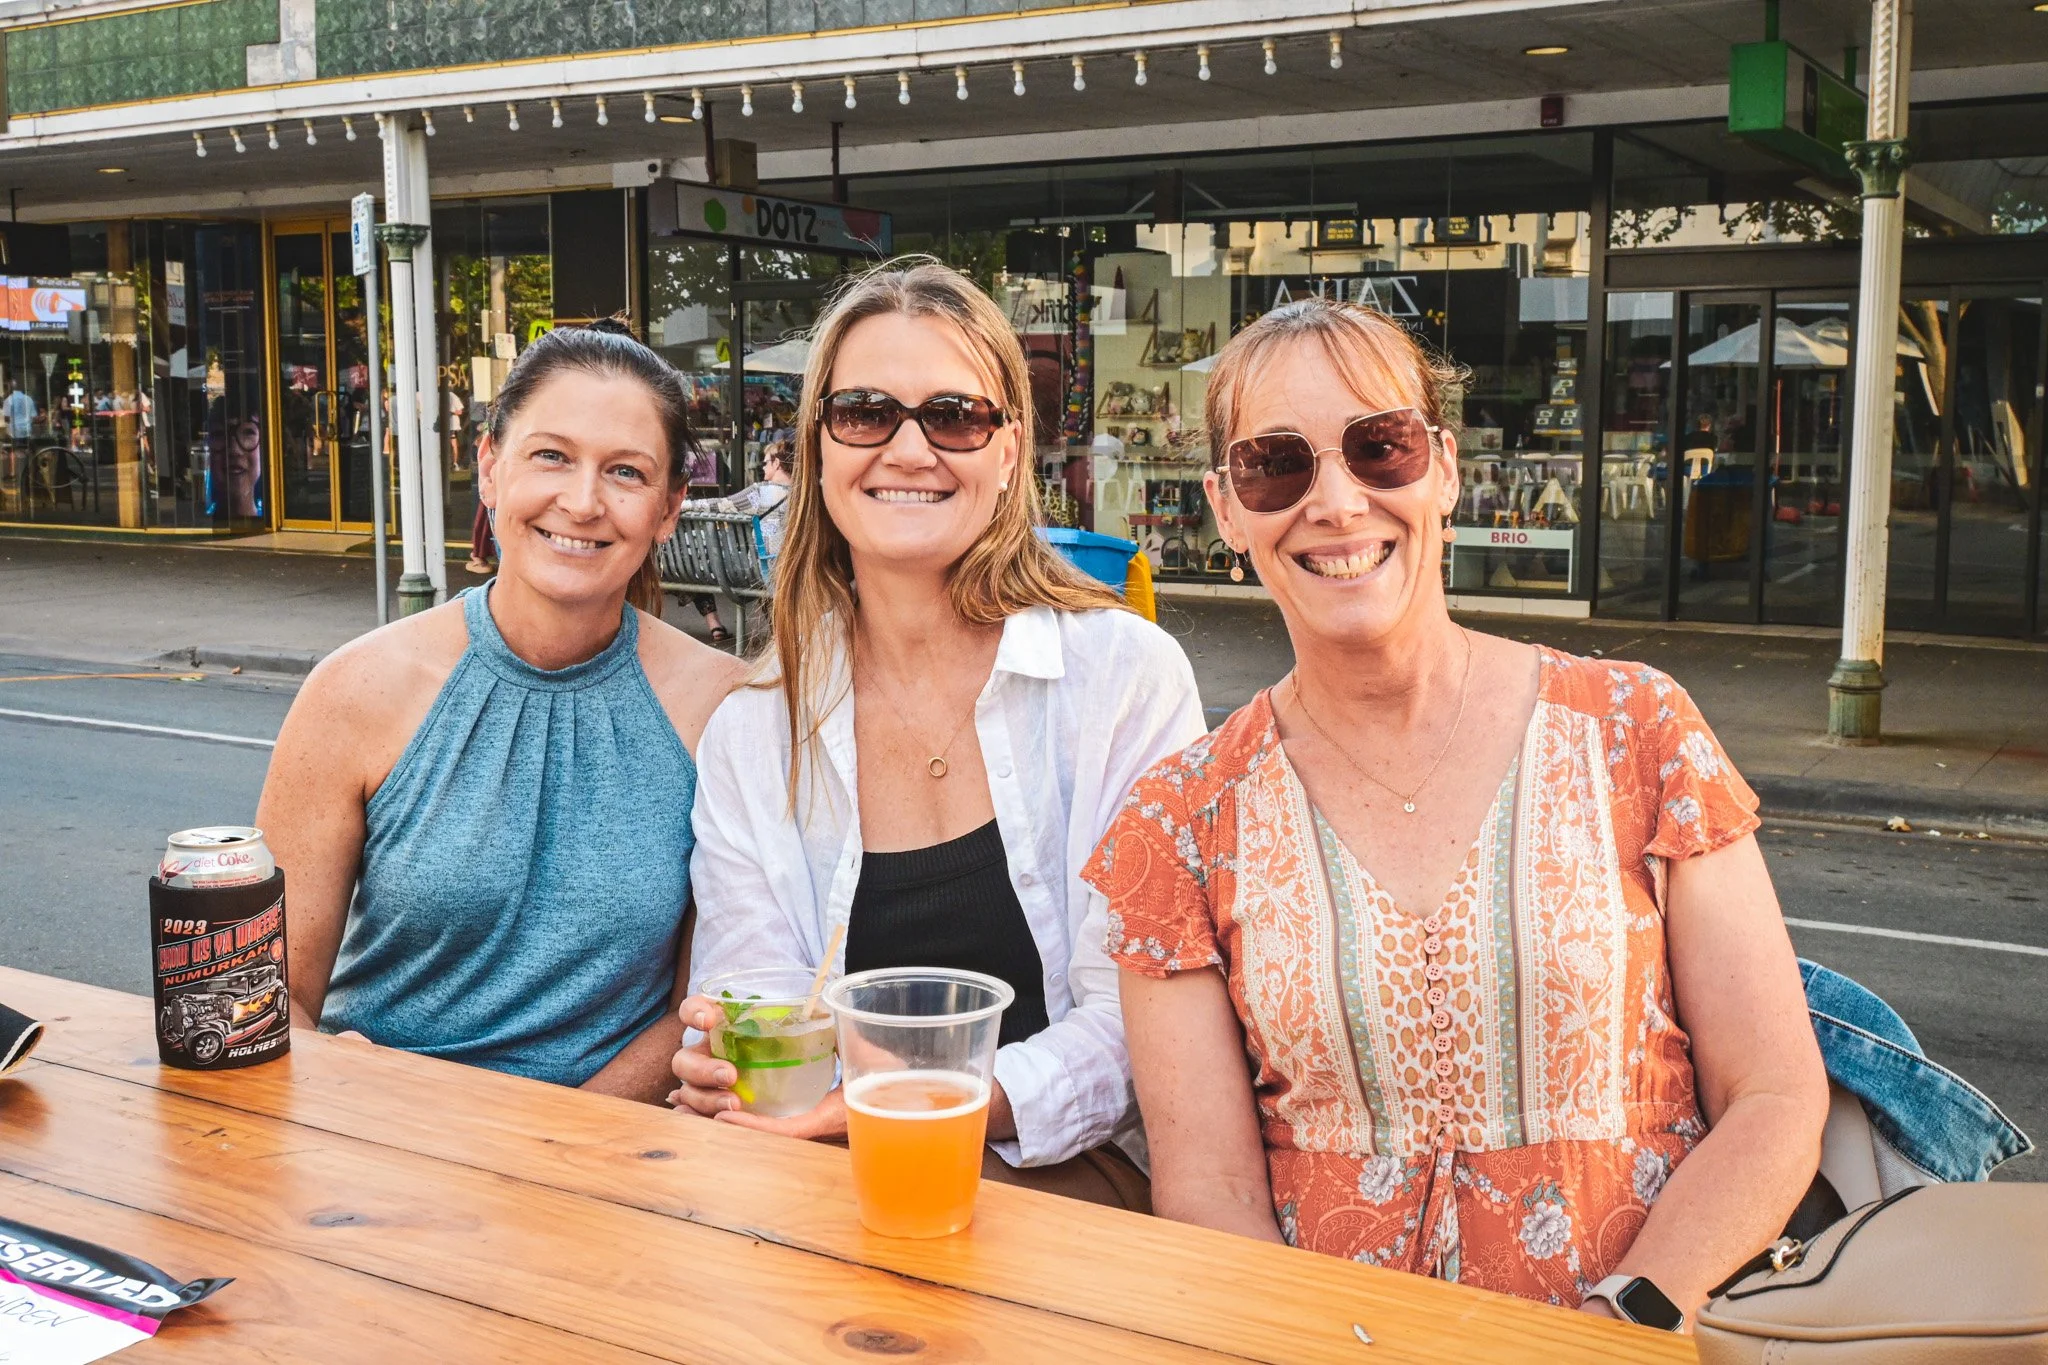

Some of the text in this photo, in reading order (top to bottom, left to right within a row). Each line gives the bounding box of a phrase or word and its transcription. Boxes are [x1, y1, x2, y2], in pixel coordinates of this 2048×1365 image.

[756, 199, 819, 243] DOTZ
[1491, 532, 1528, 544] BRIO
[193, 852, 250, 868] diet Coke
[163, 918, 208, 936] 2023
[192, 937, 212, 966] US
[214, 930, 234, 959] YA
[165, 941, 269, 986] NUMURKAH
[228, 1037, 278, 1058] HOLMES
